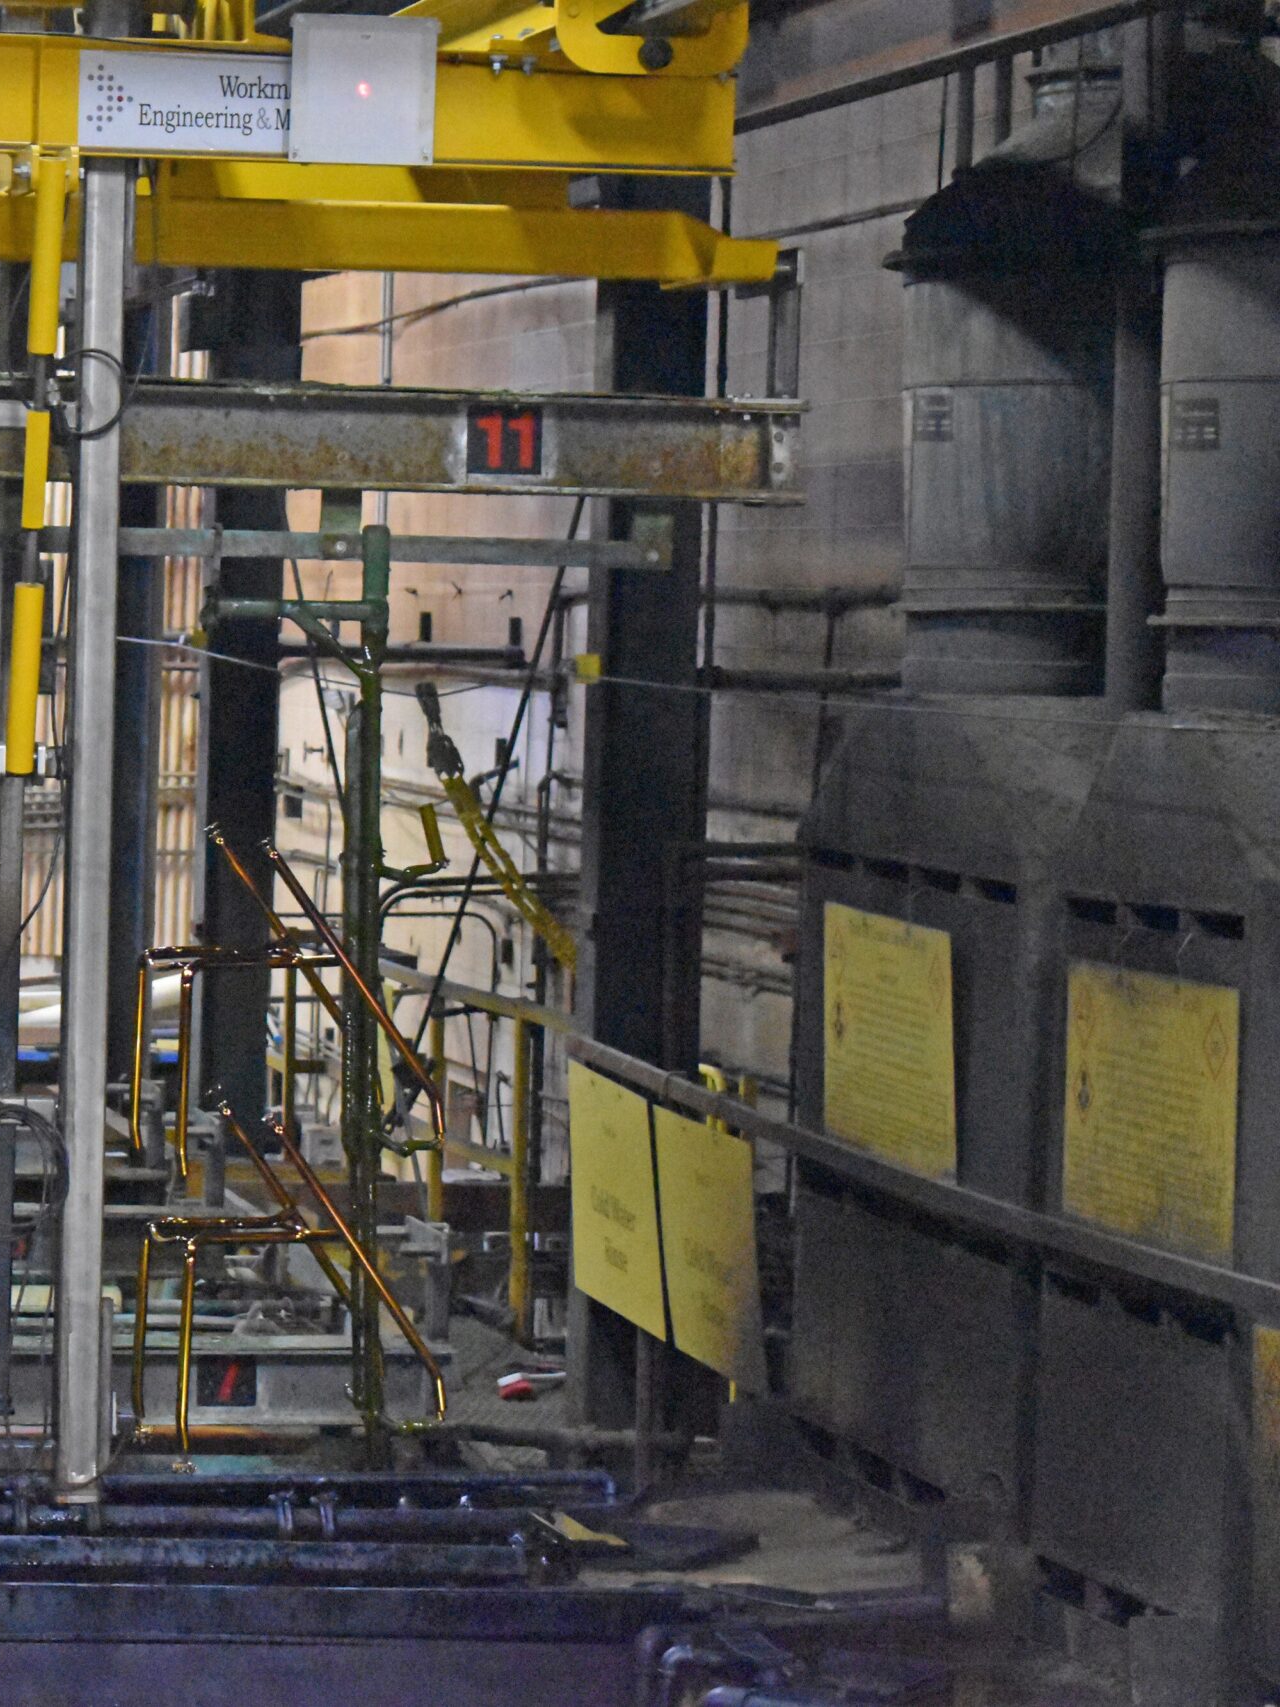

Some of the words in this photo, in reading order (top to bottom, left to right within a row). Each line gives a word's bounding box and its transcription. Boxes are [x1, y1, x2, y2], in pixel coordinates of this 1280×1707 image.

[219, 75, 291, 99] Workm
[138, 103, 253, 136] Engineering
[256, 107, 272, 130] &
[476, 411, 535, 469] 11
